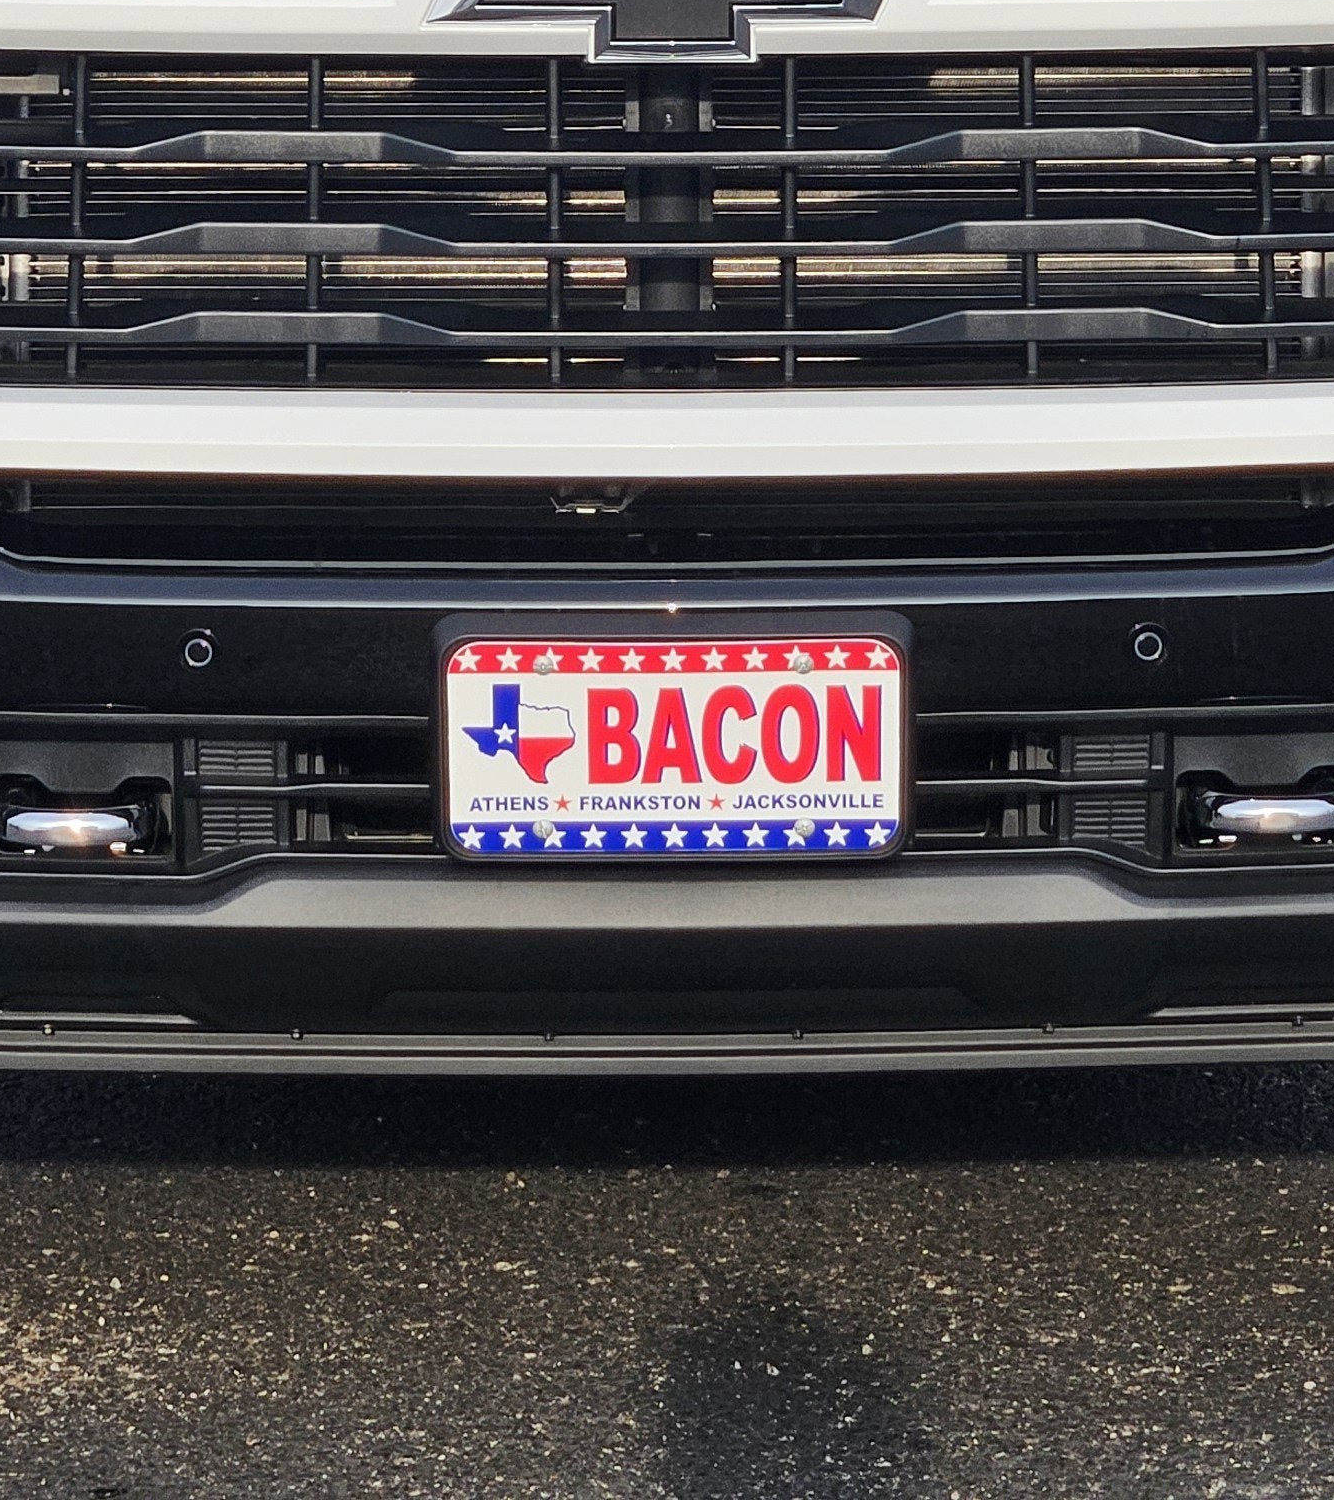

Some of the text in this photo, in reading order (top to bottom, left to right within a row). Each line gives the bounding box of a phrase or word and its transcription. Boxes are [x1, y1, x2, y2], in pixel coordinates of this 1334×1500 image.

[586, 684, 883, 785] BACON
[469, 793, 884, 812] ATHENS FRANKSTON JACKSONVILLE
